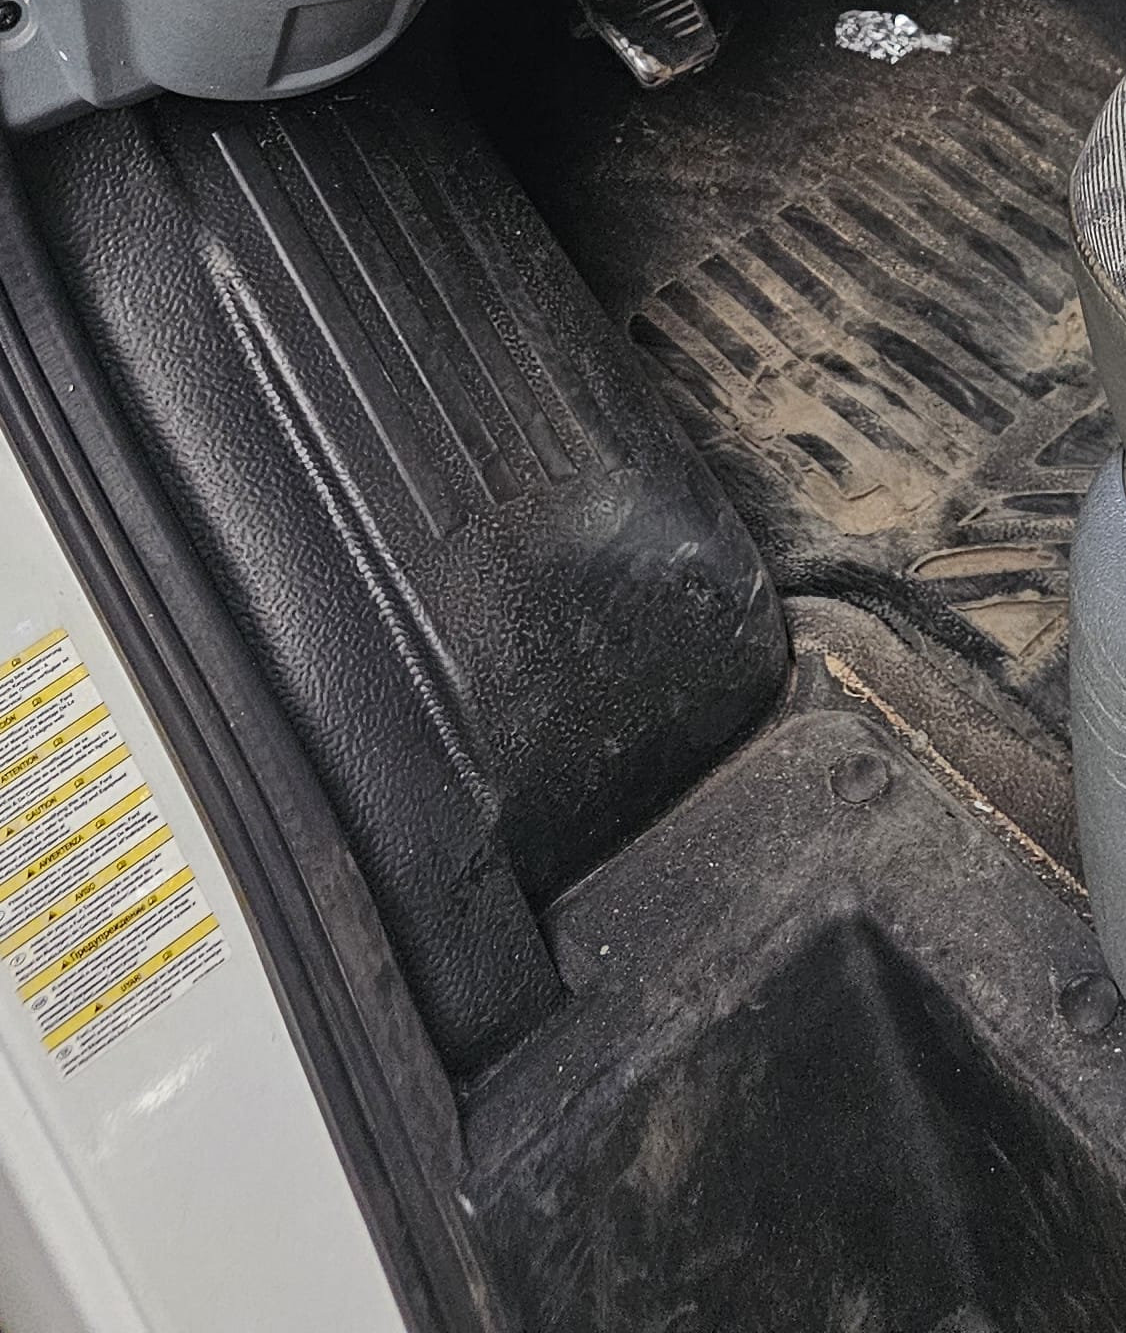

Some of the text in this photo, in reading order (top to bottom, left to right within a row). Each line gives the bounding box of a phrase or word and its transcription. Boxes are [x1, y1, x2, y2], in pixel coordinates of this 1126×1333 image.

[0, 753, 39, 783] ATTENTION
[25, 796, 57, 822] CAUTION
[39, 835, 84, 870] AVVERTENZA
[74, 882, 96, 902] AVISO
